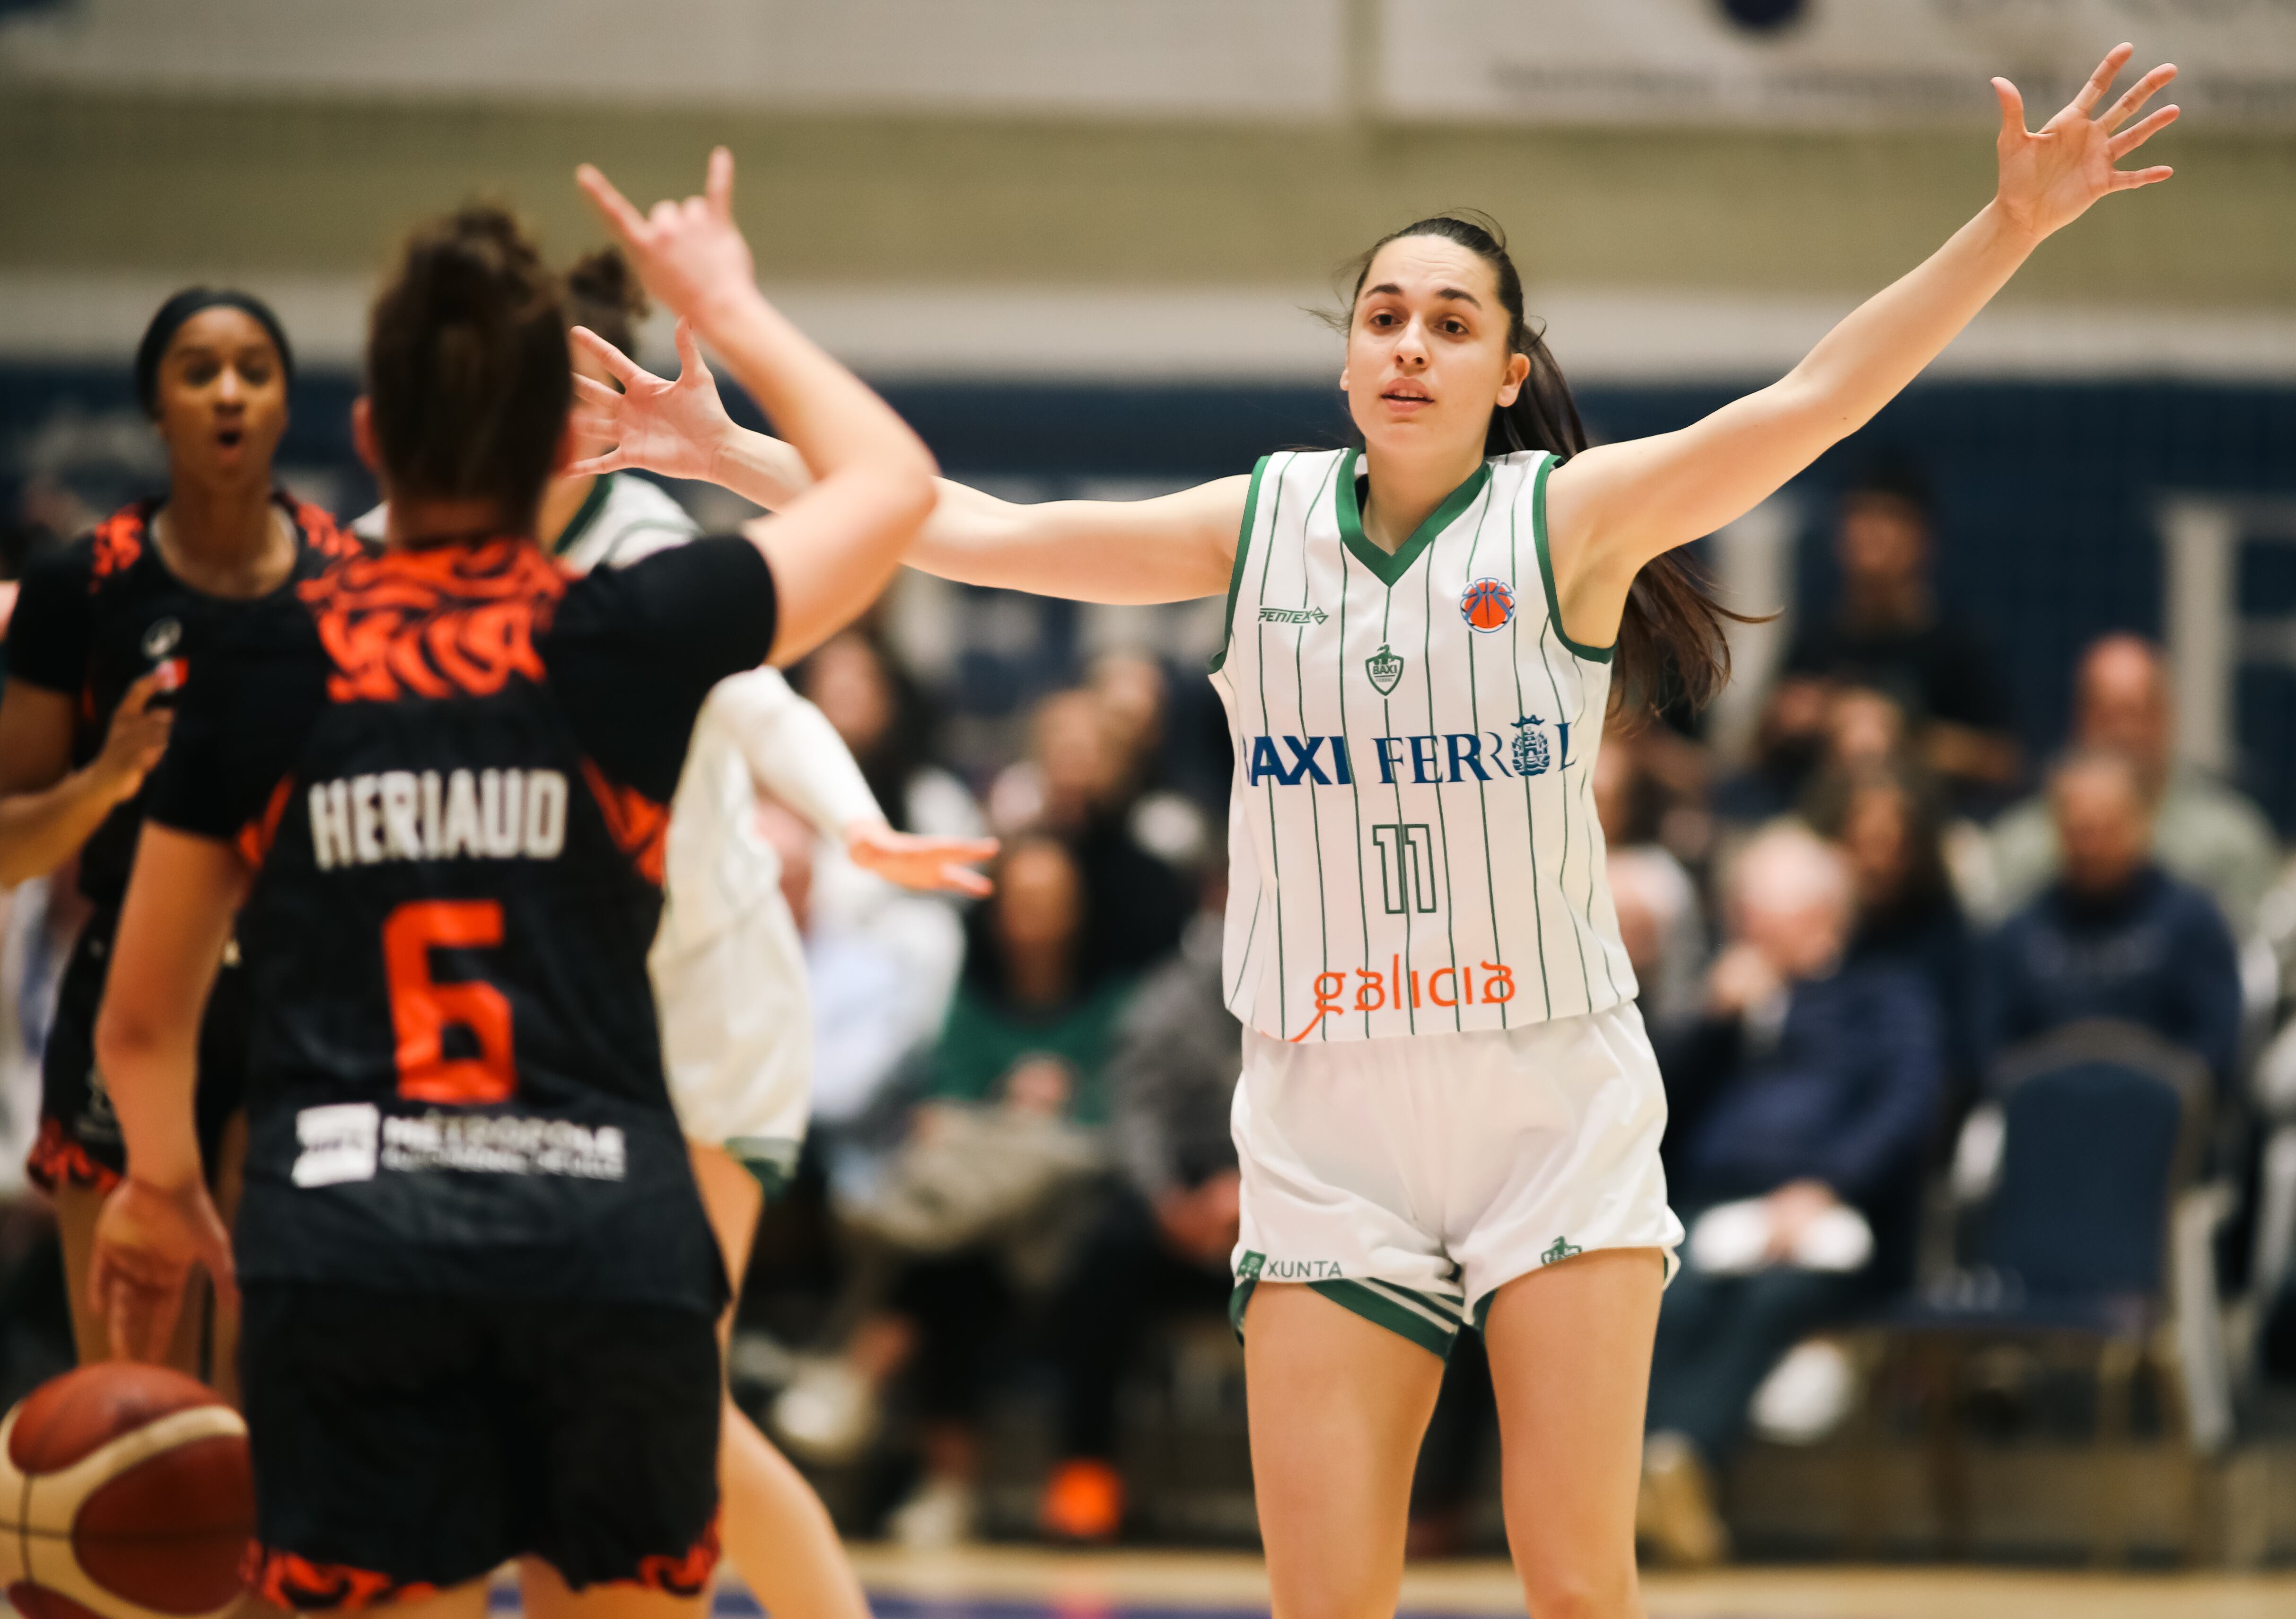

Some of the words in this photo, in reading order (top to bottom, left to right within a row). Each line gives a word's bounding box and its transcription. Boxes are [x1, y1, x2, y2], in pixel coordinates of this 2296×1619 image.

[1258, 609, 1312, 623] PENTEX
[1373, 664, 1397, 675] BAXI
[1242, 734, 1352, 786] AXI
[308, 767, 568, 871] HERIAUD
[1372, 824, 1437, 914] 11
[382, 899, 516, 1105] 6
[1290, 953, 1516, 1043] galicia
[1268, 1260, 1342, 1278] XUNTA
